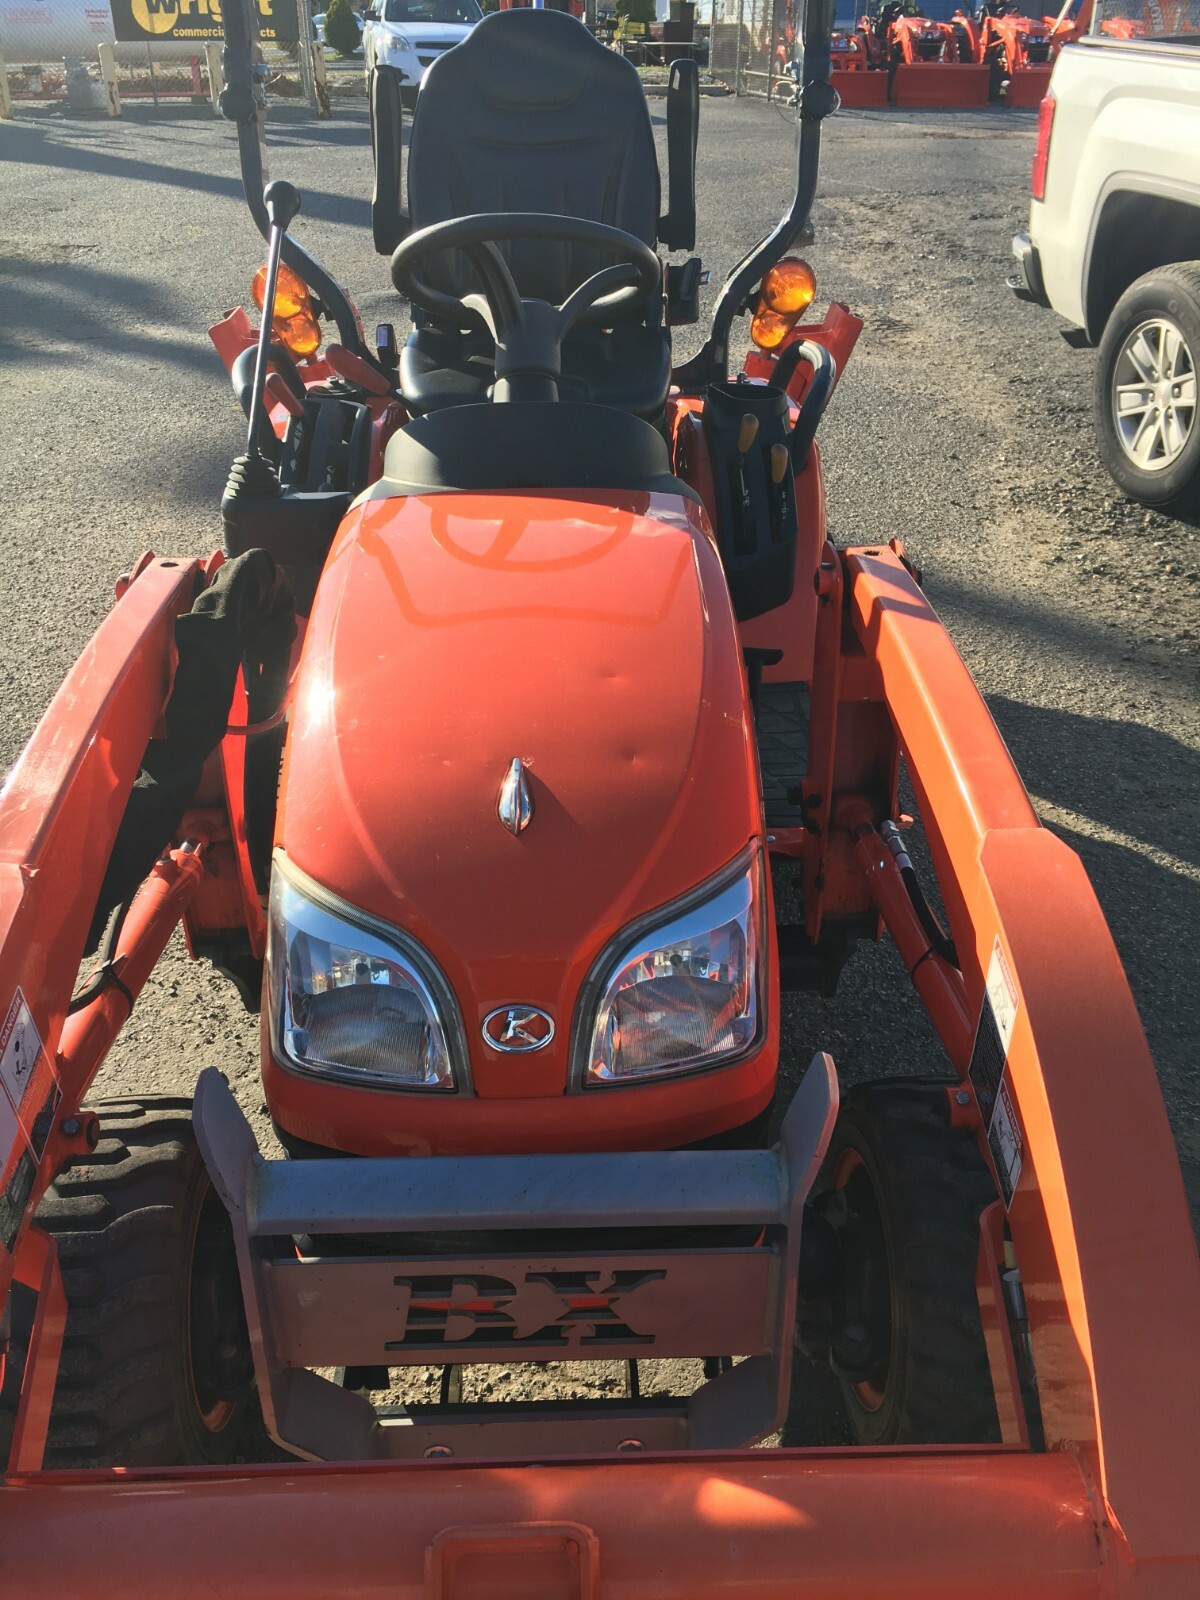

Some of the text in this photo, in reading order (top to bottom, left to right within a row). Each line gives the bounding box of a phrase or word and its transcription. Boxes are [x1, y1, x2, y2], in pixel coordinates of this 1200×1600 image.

[145, 0, 273, 22] wrigt
[173, 26, 226, 37] commercia
[384, 1269, 667, 1351] BX
